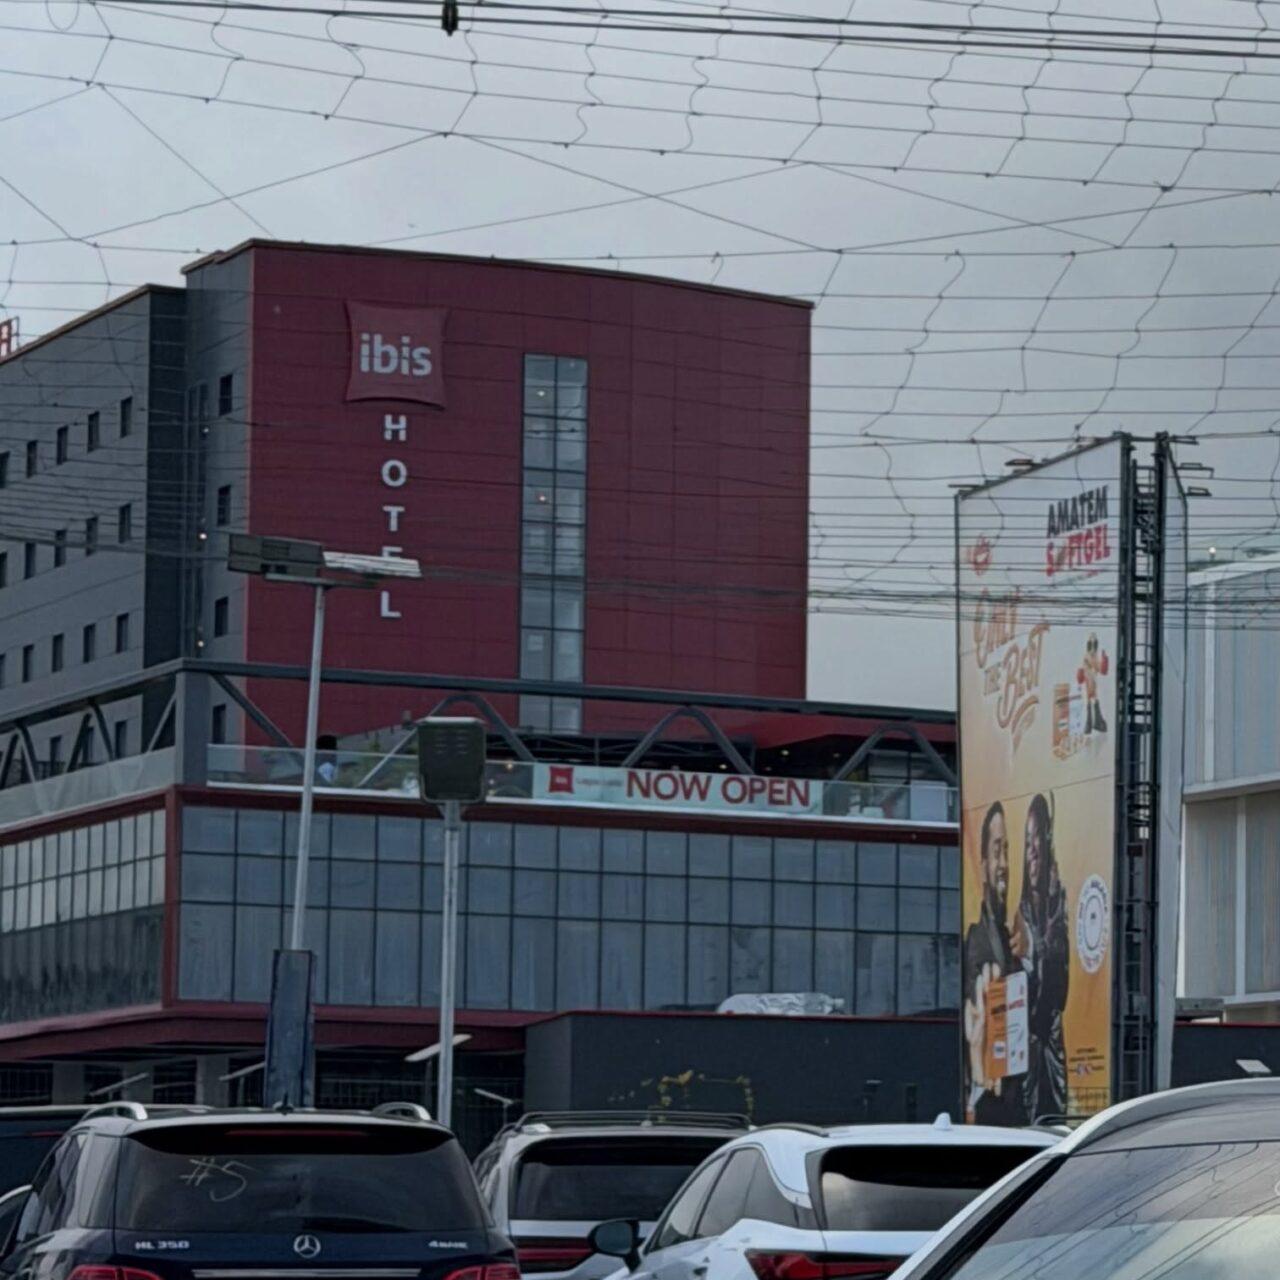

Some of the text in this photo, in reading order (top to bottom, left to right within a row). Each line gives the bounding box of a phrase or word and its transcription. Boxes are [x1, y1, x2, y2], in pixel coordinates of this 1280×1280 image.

[360, 332, 433, 377] ibis
[1046, 484, 1109, 539] AMATEM
[626, 770, 811, 807] NOW OPEN
[158, 1240, 190, 1250] 350
